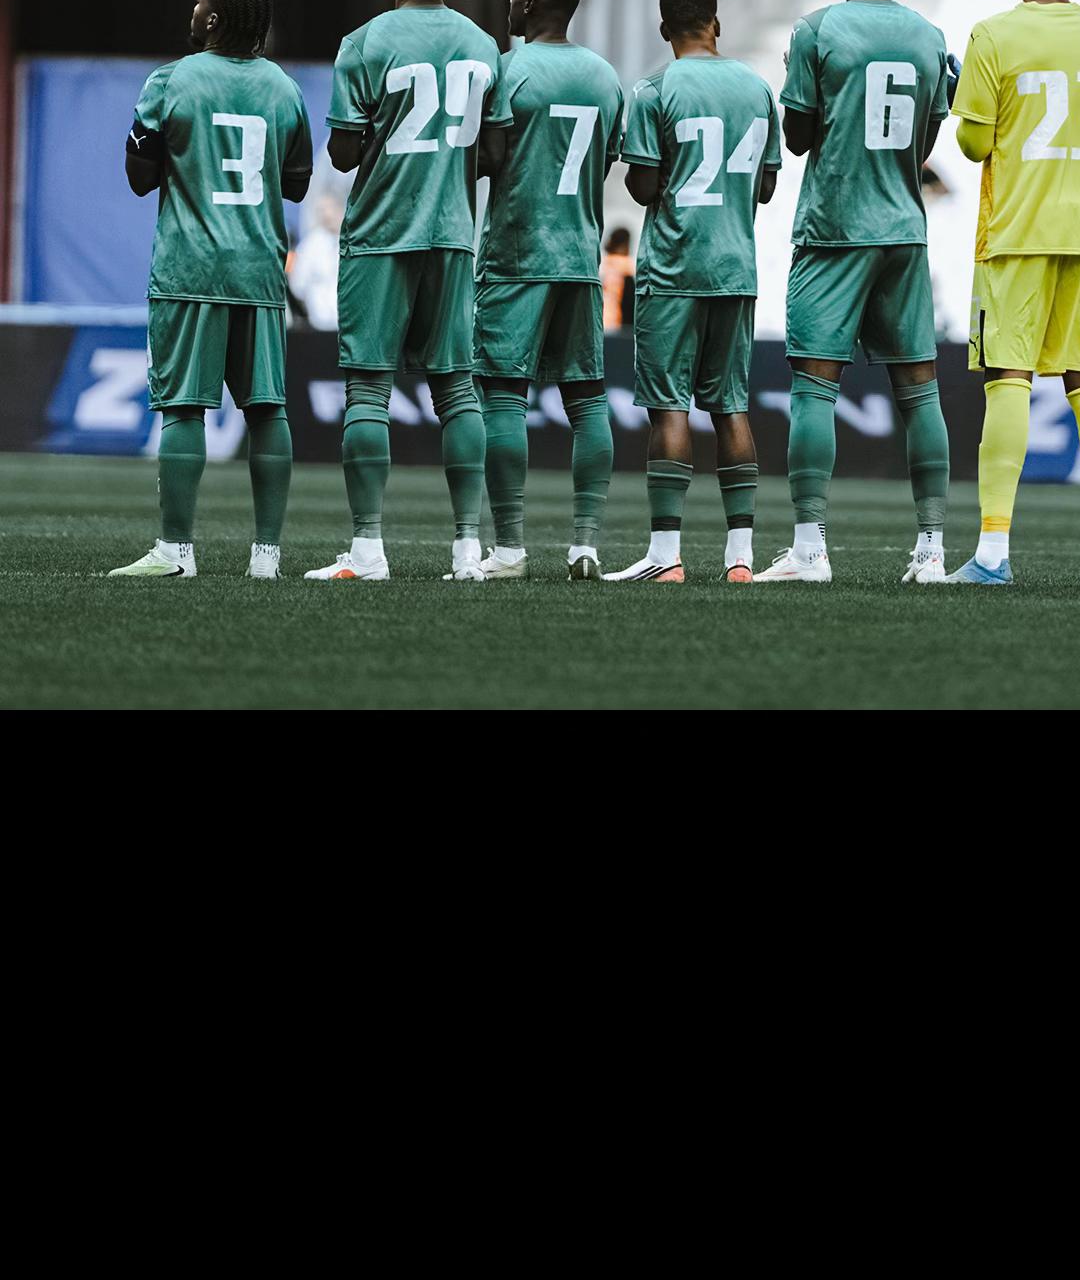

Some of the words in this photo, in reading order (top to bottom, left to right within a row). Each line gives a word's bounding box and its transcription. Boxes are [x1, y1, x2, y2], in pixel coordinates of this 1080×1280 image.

[386, 59, 492, 155] 29
[549, 104, 599, 195] 7
[865, 61, 916, 150] 6
[212, 112, 267, 206] 3
[675, 117, 769, 207] 24
